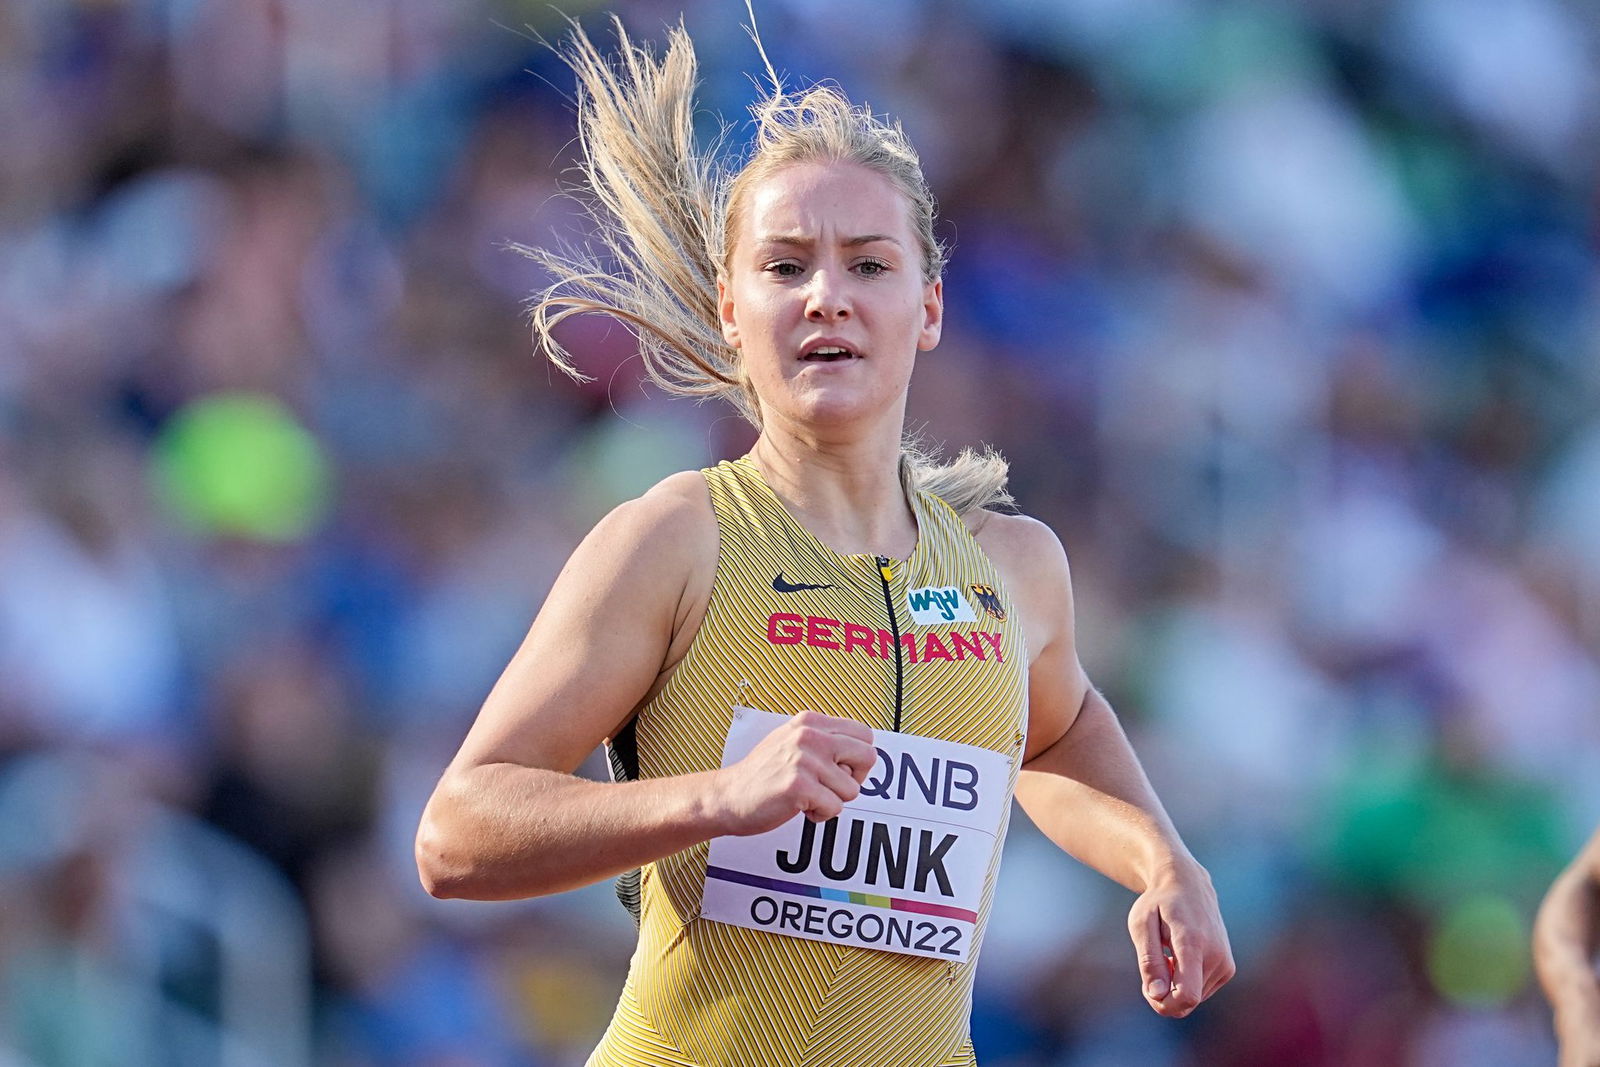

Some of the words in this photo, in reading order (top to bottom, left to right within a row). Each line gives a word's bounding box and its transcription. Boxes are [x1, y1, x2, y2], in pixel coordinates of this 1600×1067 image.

[766, 612, 1004, 664] GERMANY
[858, 746, 979, 811] QNB
[775, 813, 959, 898] JUNK
[750, 895, 963, 957] OREGON22
